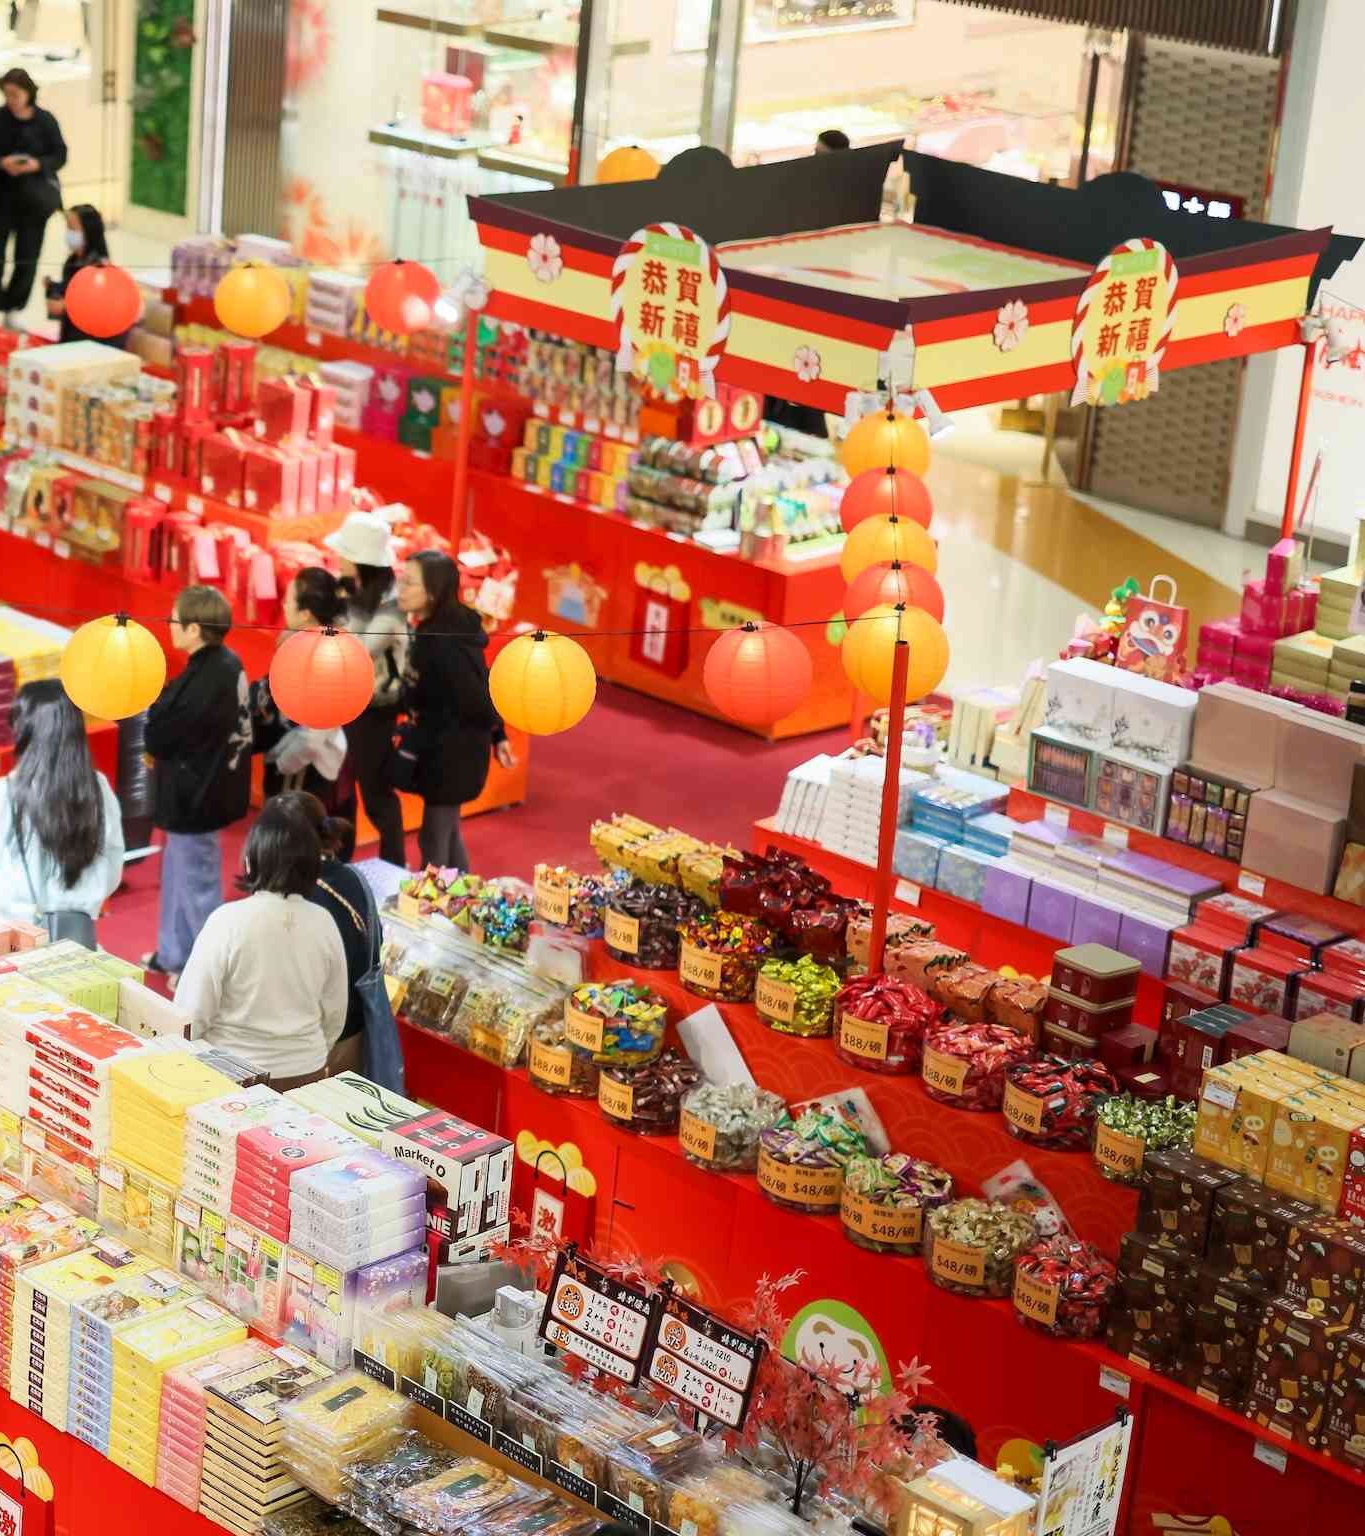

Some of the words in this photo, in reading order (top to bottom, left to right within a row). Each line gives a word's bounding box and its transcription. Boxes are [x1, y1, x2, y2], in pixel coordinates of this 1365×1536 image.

[641, 260, 702, 306] 恭賀
[1102, 276, 1158, 316] 恭賀
[638, 301, 700, 348] 新禧
[1096, 316, 1152, 358] 新禧
[394, 1145, 436, 1170] Market
[436, 1164, 446, 1178] O
[552, 1327, 571, 1345] $130
[655, 1367, 676, 1386] $200
